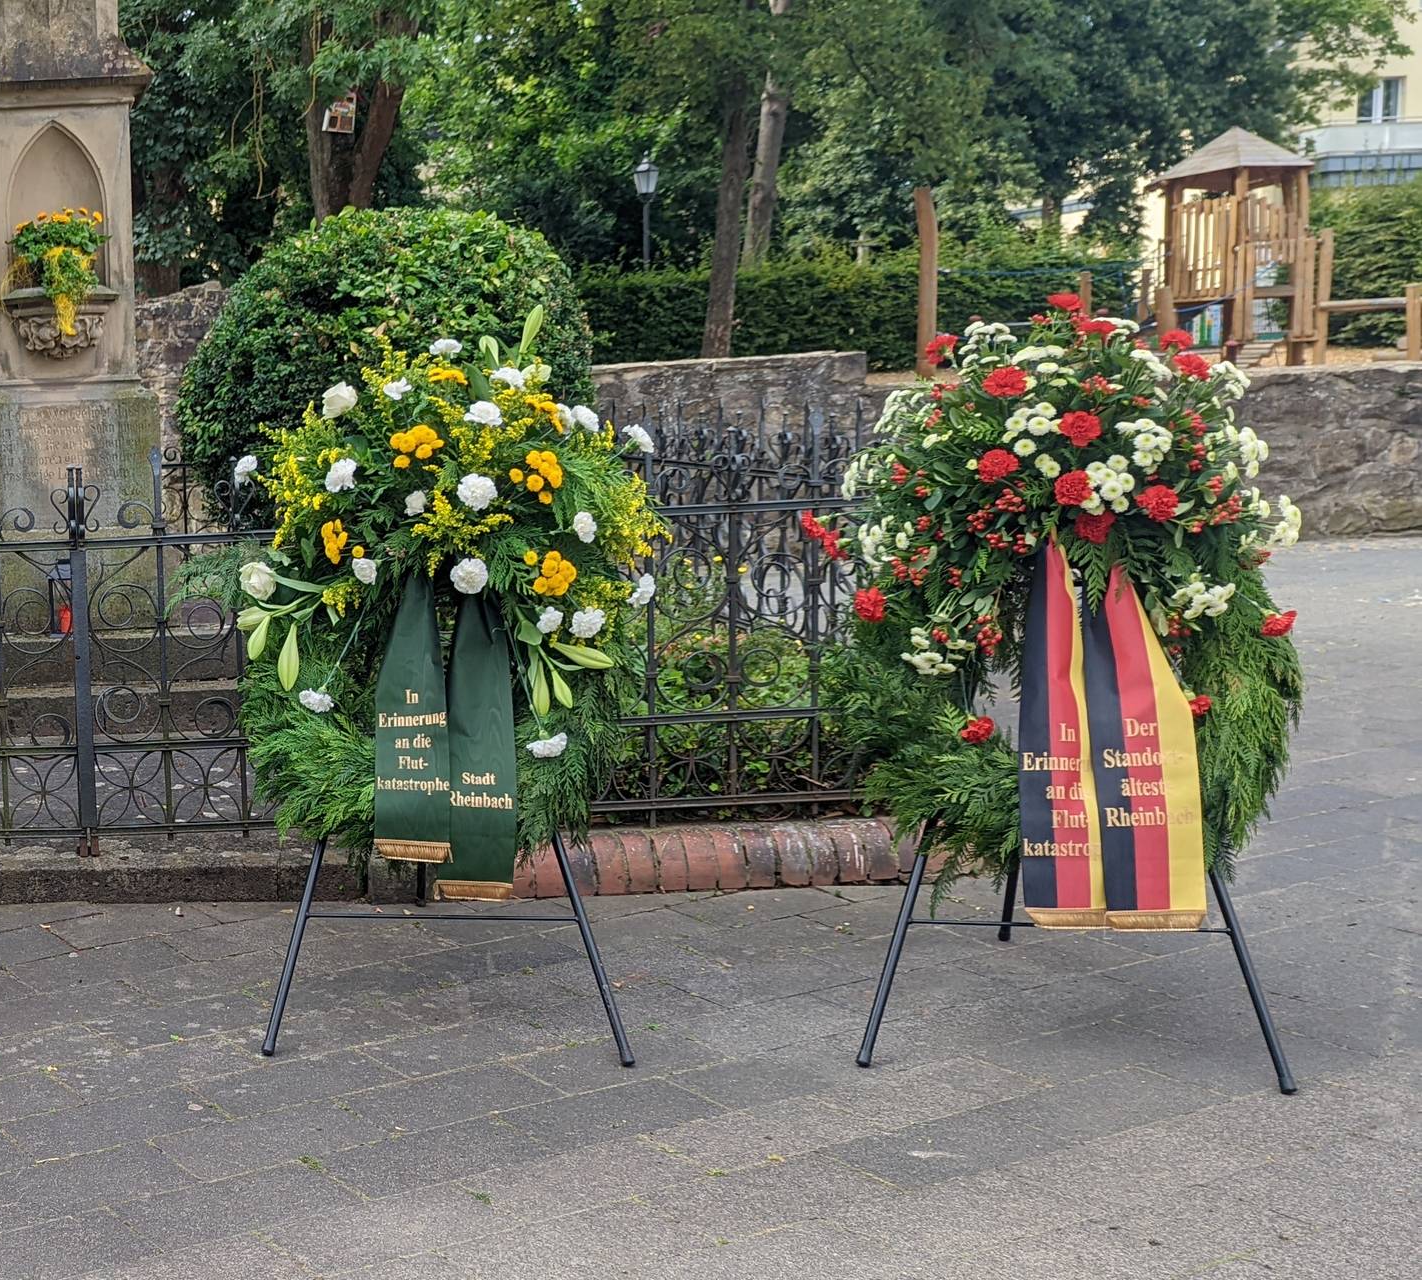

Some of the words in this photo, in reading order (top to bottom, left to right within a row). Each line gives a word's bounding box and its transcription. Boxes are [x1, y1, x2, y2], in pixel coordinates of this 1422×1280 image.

[405, 688, 419, 705] In
[378, 711, 447, 728] Erinnerung
[1124, 718, 1157, 738] Der
[395, 737, 410, 749] an
[412, 733, 432, 749] die
[1058, 723, 1076, 742] In
[398, 755, 429, 770] Flut-
[377, 776, 450, 796] katastrophe
[461, 772, 496, 786] Stadt
[450, 790, 514, 810] Rheinbach
[1046, 785, 1066, 800] an
[1070, 782, 1090, 801] di
